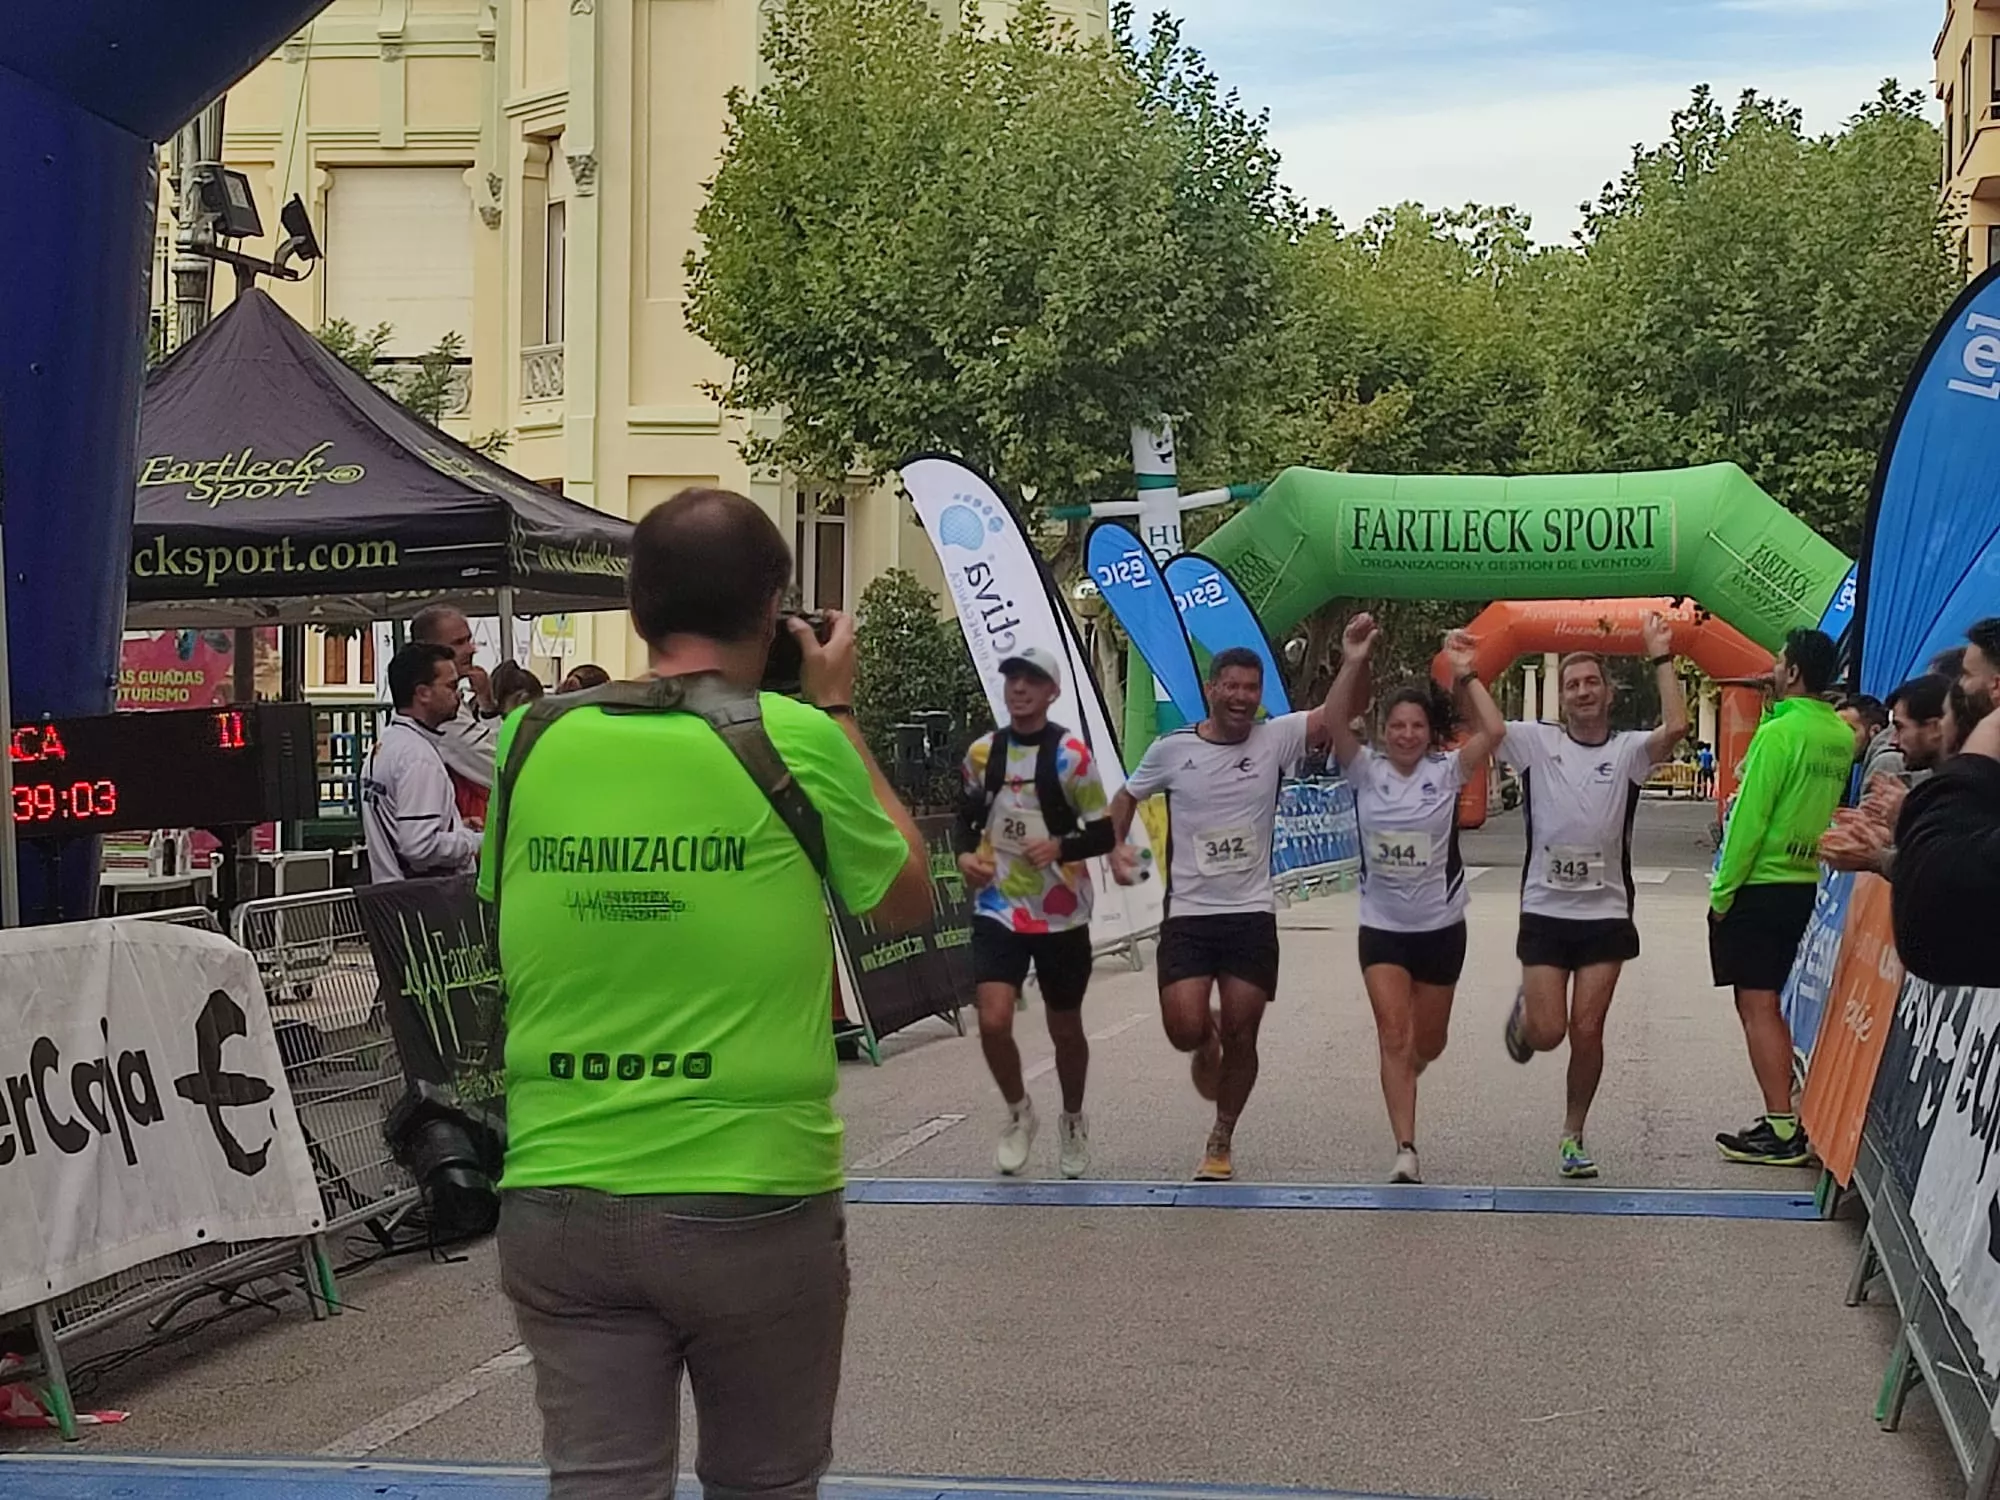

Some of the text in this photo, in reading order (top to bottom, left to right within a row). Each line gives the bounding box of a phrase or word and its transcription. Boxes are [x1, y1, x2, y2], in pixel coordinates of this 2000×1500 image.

[186, 475, 315, 508] Sport
[1351, 505, 1660, 553] FARTLECK SPORT
[134, 535, 398, 587] cksport.com
[1557, 558, 1578, 570] DE
[1581, 556, 1651, 569] EVENTOS
[138, 668, 205, 685] GUIADAS
[1003, 817, 1027, 837] 28
[528, 827, 746, 873] ORGANIZACIÓN
[1204, 836, 1245, 857] 342
[1378, 842, 1416, 860] 344
[1551, 859, 1589, 877] 343
